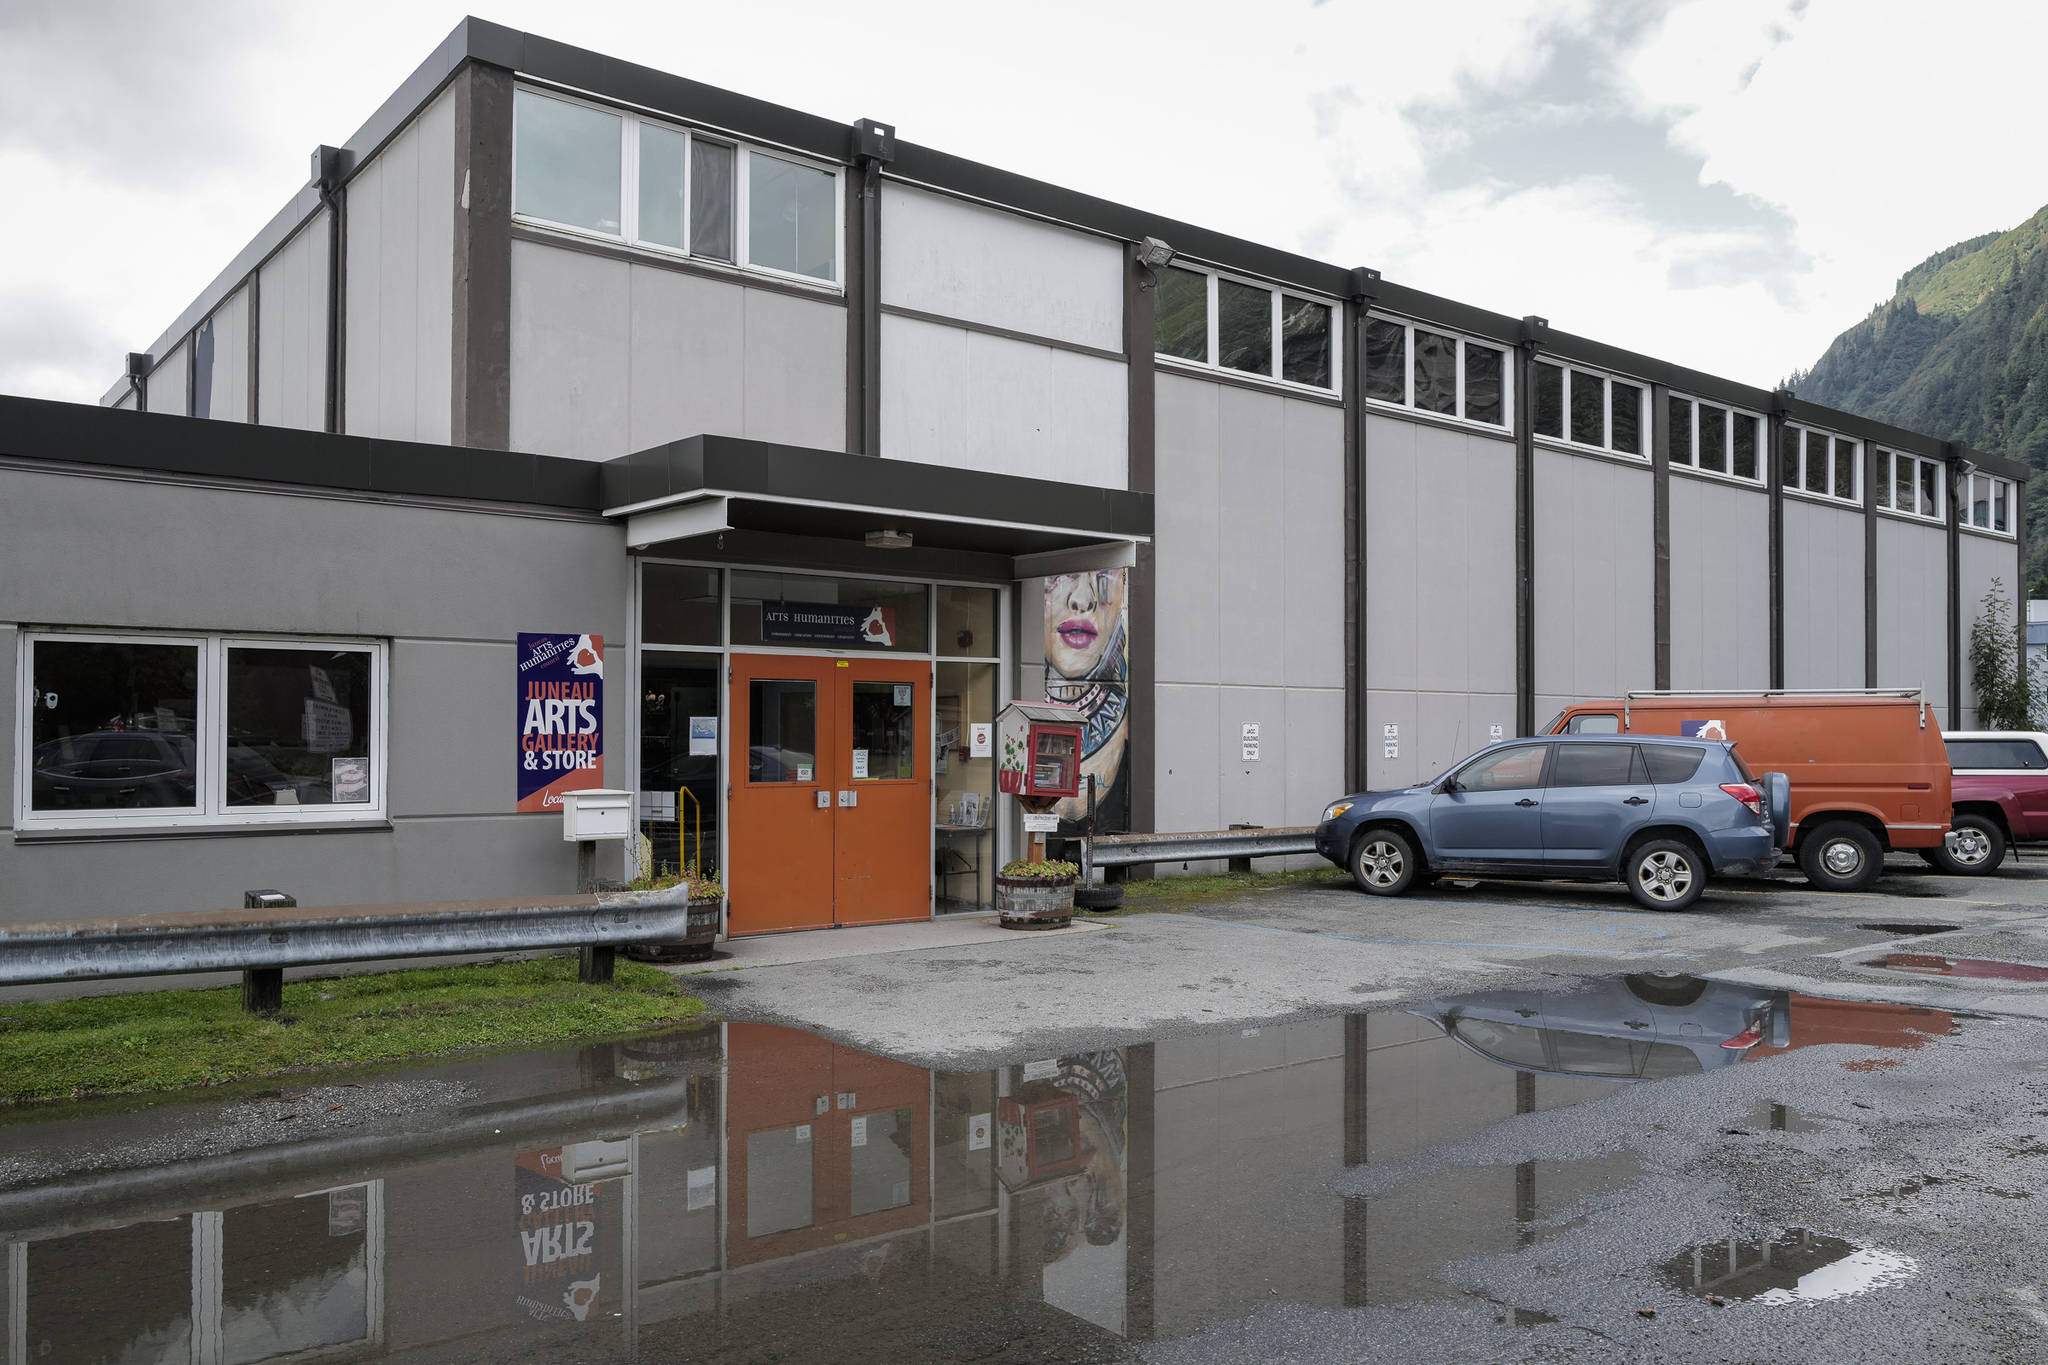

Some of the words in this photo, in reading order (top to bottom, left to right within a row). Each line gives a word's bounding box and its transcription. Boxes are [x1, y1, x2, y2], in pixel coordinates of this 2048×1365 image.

[525, 681, 594, 700] JUNEAU
[523, 699, 597, 735] ARTS
[522, 733, 599, 753] GALLERY
[523, 750, 538, 770] &
[542, 751, 597, 770] STORE
